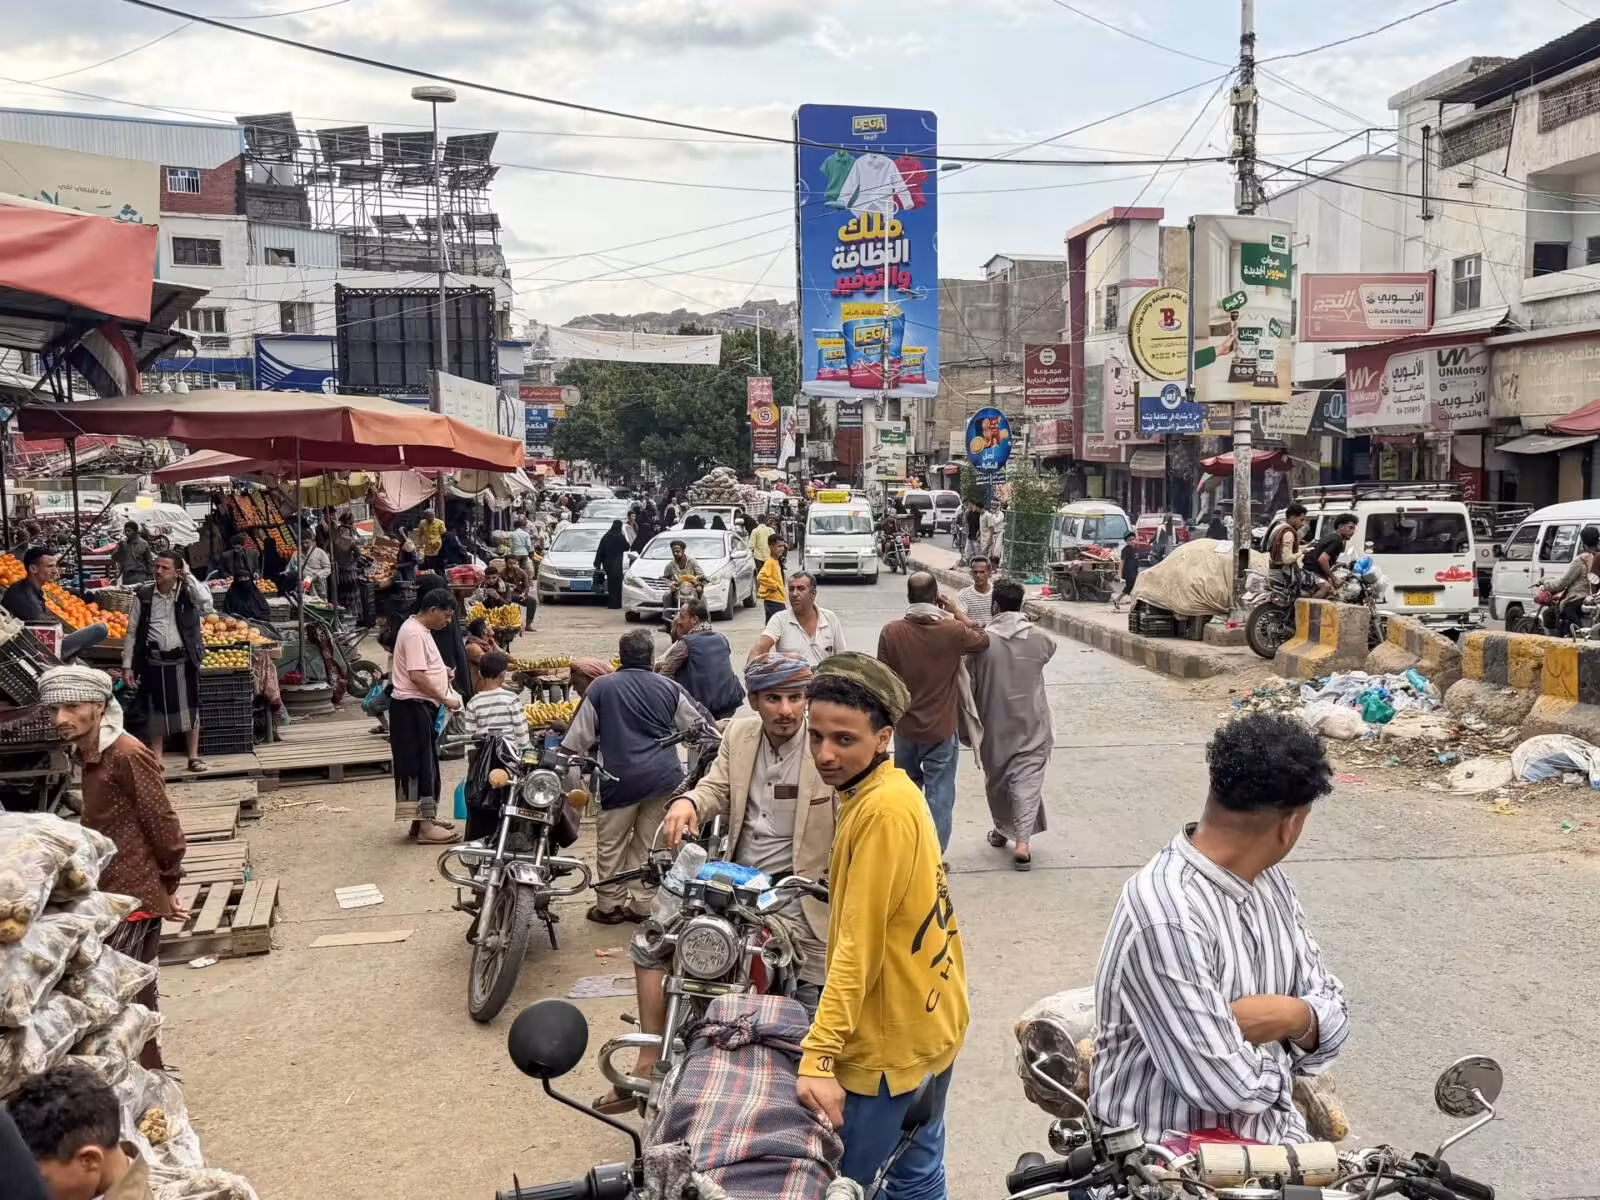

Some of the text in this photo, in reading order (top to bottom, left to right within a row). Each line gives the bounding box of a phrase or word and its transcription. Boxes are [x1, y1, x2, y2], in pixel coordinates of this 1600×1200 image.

[853, 117, 885, 130] LEGA
[58, 183, 112, 196] ماء طبيعي نقي
[838, 211, 903, 242] ملك
[831, 239, 909, 270] النظافة
[831, 266, 912, 297] والتوفير
[1377, 289, 1425, 305] الأيوبي
[1160, 308, 1176, 327] B
[856, 327, 887, 341] LEG
[1033, 367, 1062, 376] مجموعة
[1392, 357, 1424, 383] الأيوبي
[1439, 366, 1488, 377] UNMoney
[1437, 388, 1486, 409] الأيوبي
